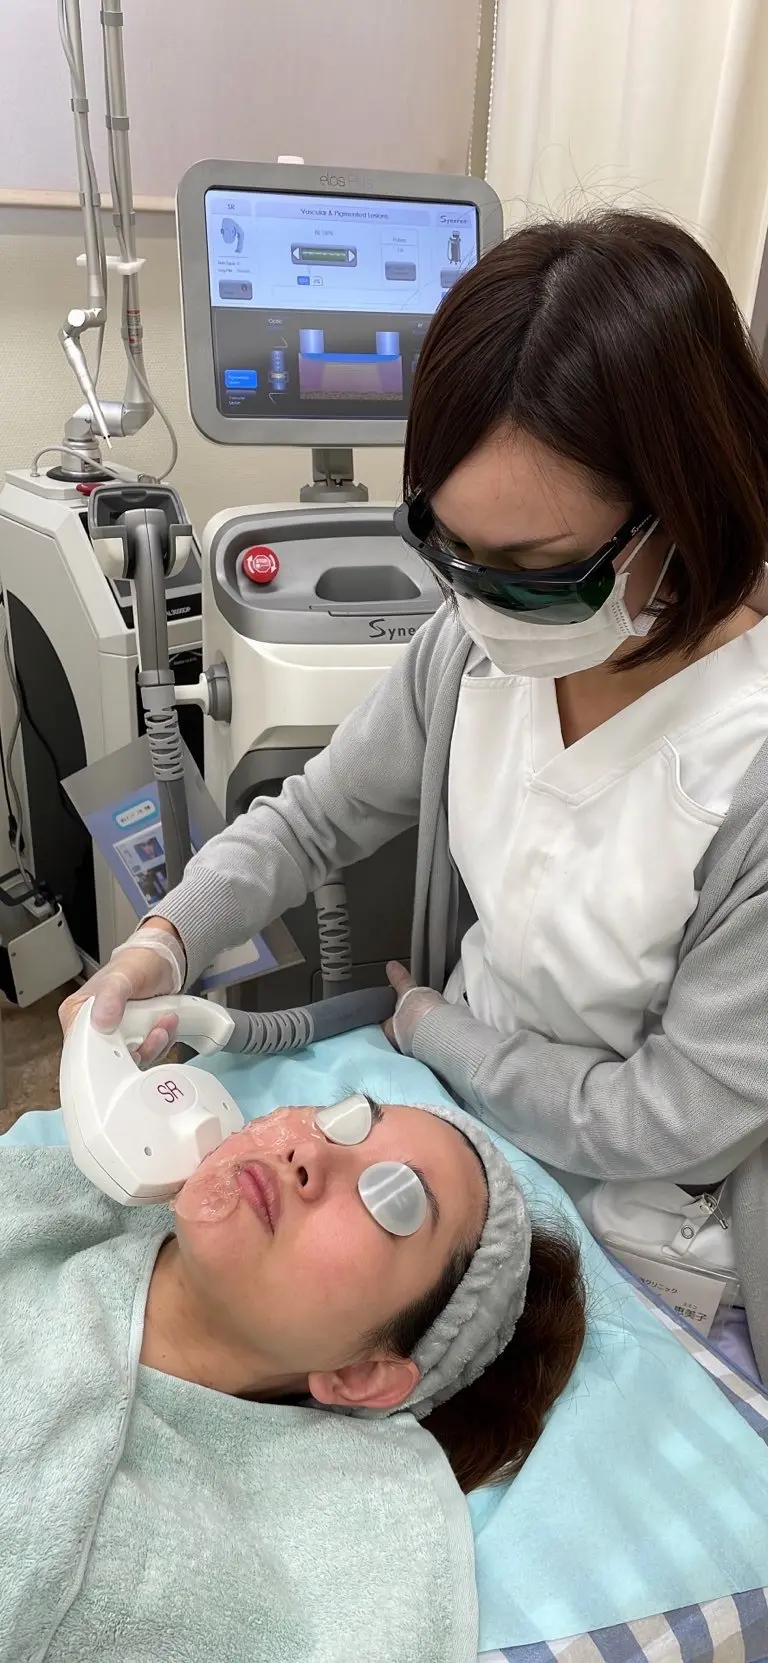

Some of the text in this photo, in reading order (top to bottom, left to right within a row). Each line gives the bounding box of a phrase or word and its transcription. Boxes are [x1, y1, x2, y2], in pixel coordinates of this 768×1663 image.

[300, 208, 327, 217] Vascular
[334, 210, 367, 219] Pigmented
[157, 1080, 185, 1104] SR
